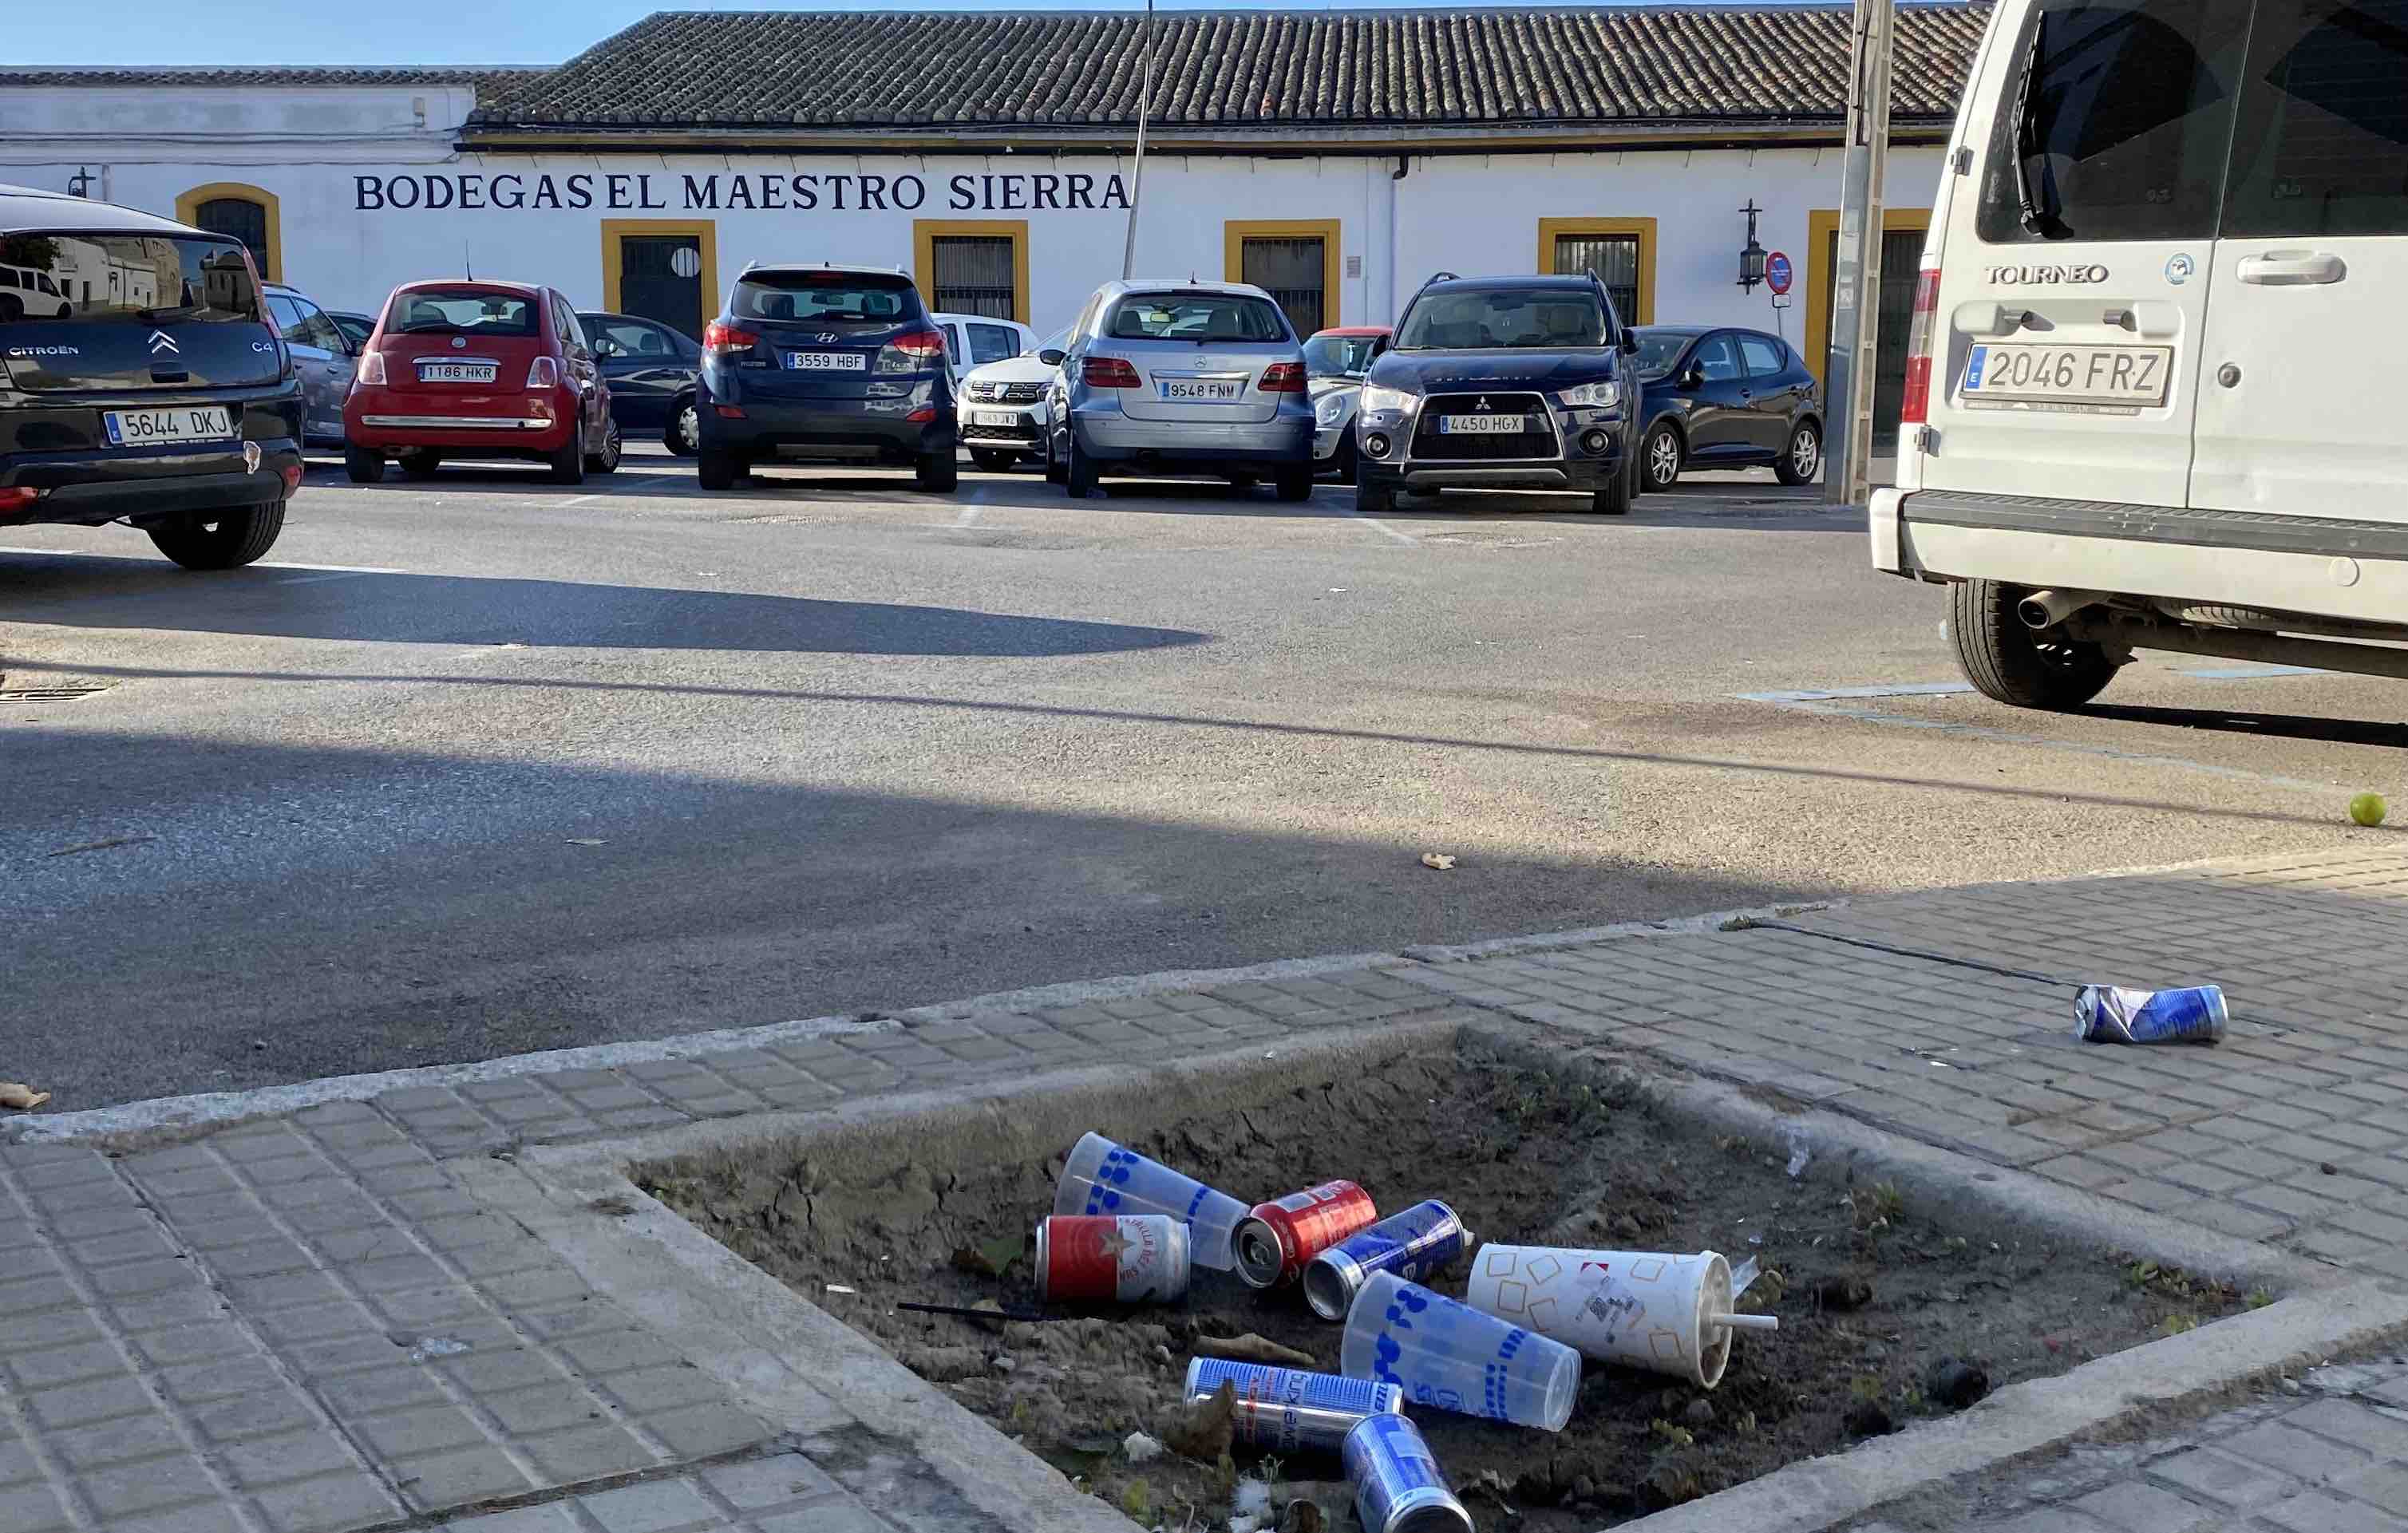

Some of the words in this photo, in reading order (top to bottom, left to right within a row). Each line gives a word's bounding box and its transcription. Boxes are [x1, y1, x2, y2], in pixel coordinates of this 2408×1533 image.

[354, 174, 593, 210] BODEGAS
[605, 174, 666, 209] EL
[682, 174, 925, 210] MAESTRO
[949, 174, 1131, 210] SIERRA
[1985, 264, 2109, 285] TOURNEO
[251, 341, 273, 353] C4
[797, 354, 831, 368] 3559
[837, 355, 864, 368] HBF
[429, 366, 461, 377] 1186
[466, 367, 492, 378] HKR
[1970, 372, 1978, 383] E
[1988, 352, 2075, 388] 2046
[2085, 353, 2159, 390] FRZ
[1171, 384, 1204, 397] 9548
[1209, 385, 1234, 398] FNM
[125, 413, 180, 437] 5644
[191, 409, 227, 433] DKJ
[1451, 417, 1488, 433] 4450
[1493, 417, 1520, 431] HGX
